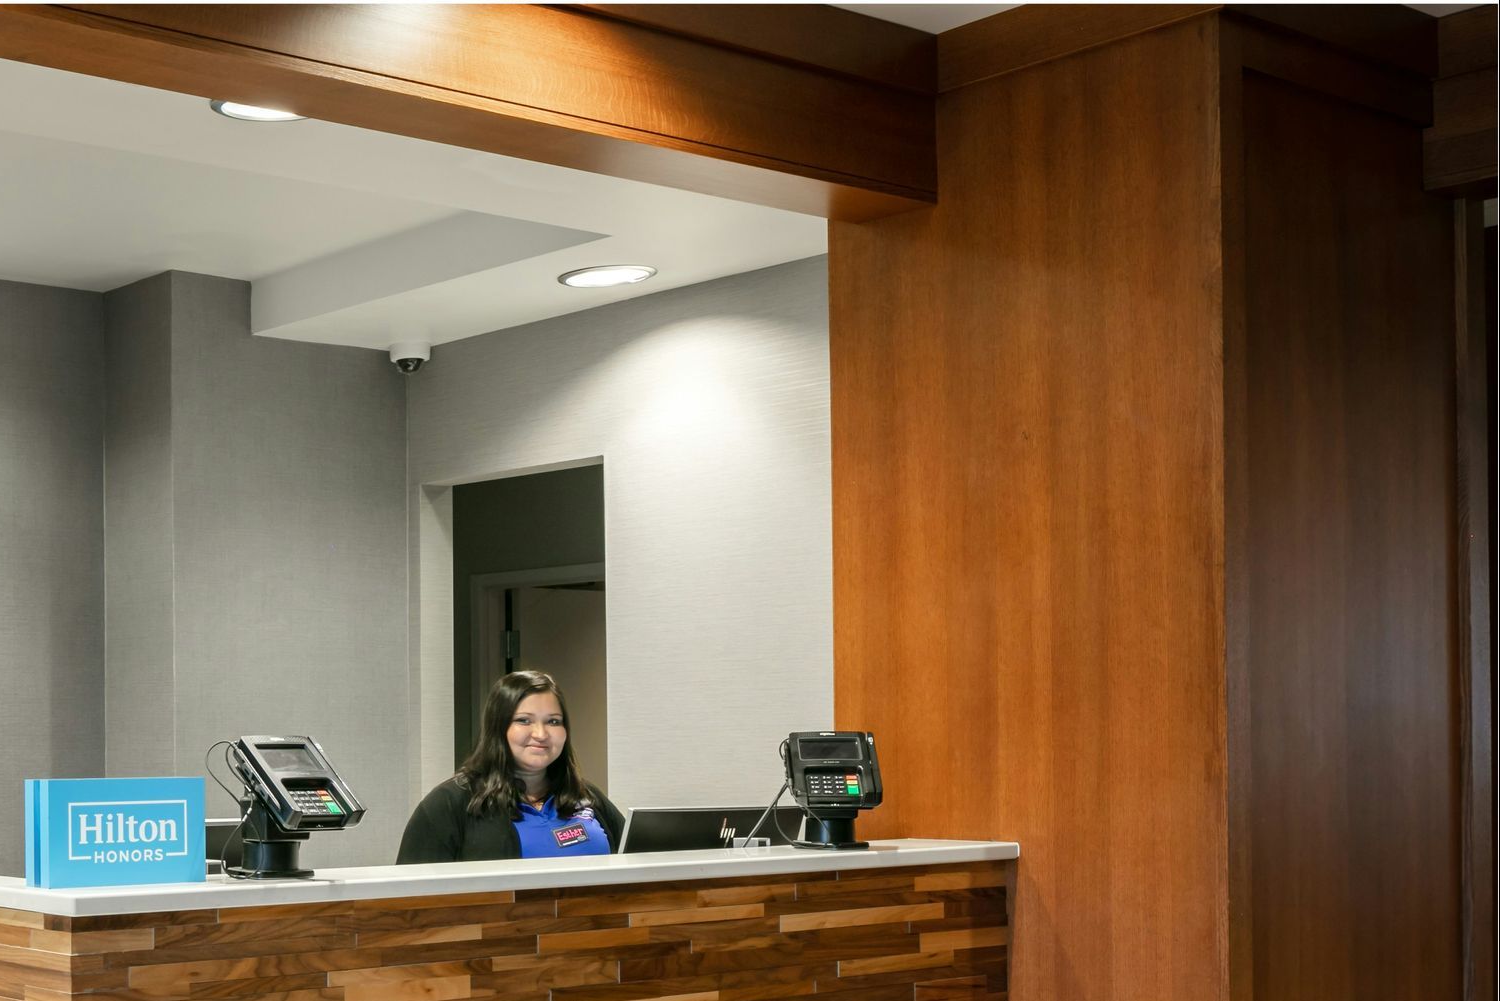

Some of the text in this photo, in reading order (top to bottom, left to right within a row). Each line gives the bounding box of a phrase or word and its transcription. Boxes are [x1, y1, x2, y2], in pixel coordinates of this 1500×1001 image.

[79, 813, 178, 845] Hilton
[556, 828, 583, 841] Esther
[94, 848, 164, 864] HONORS
